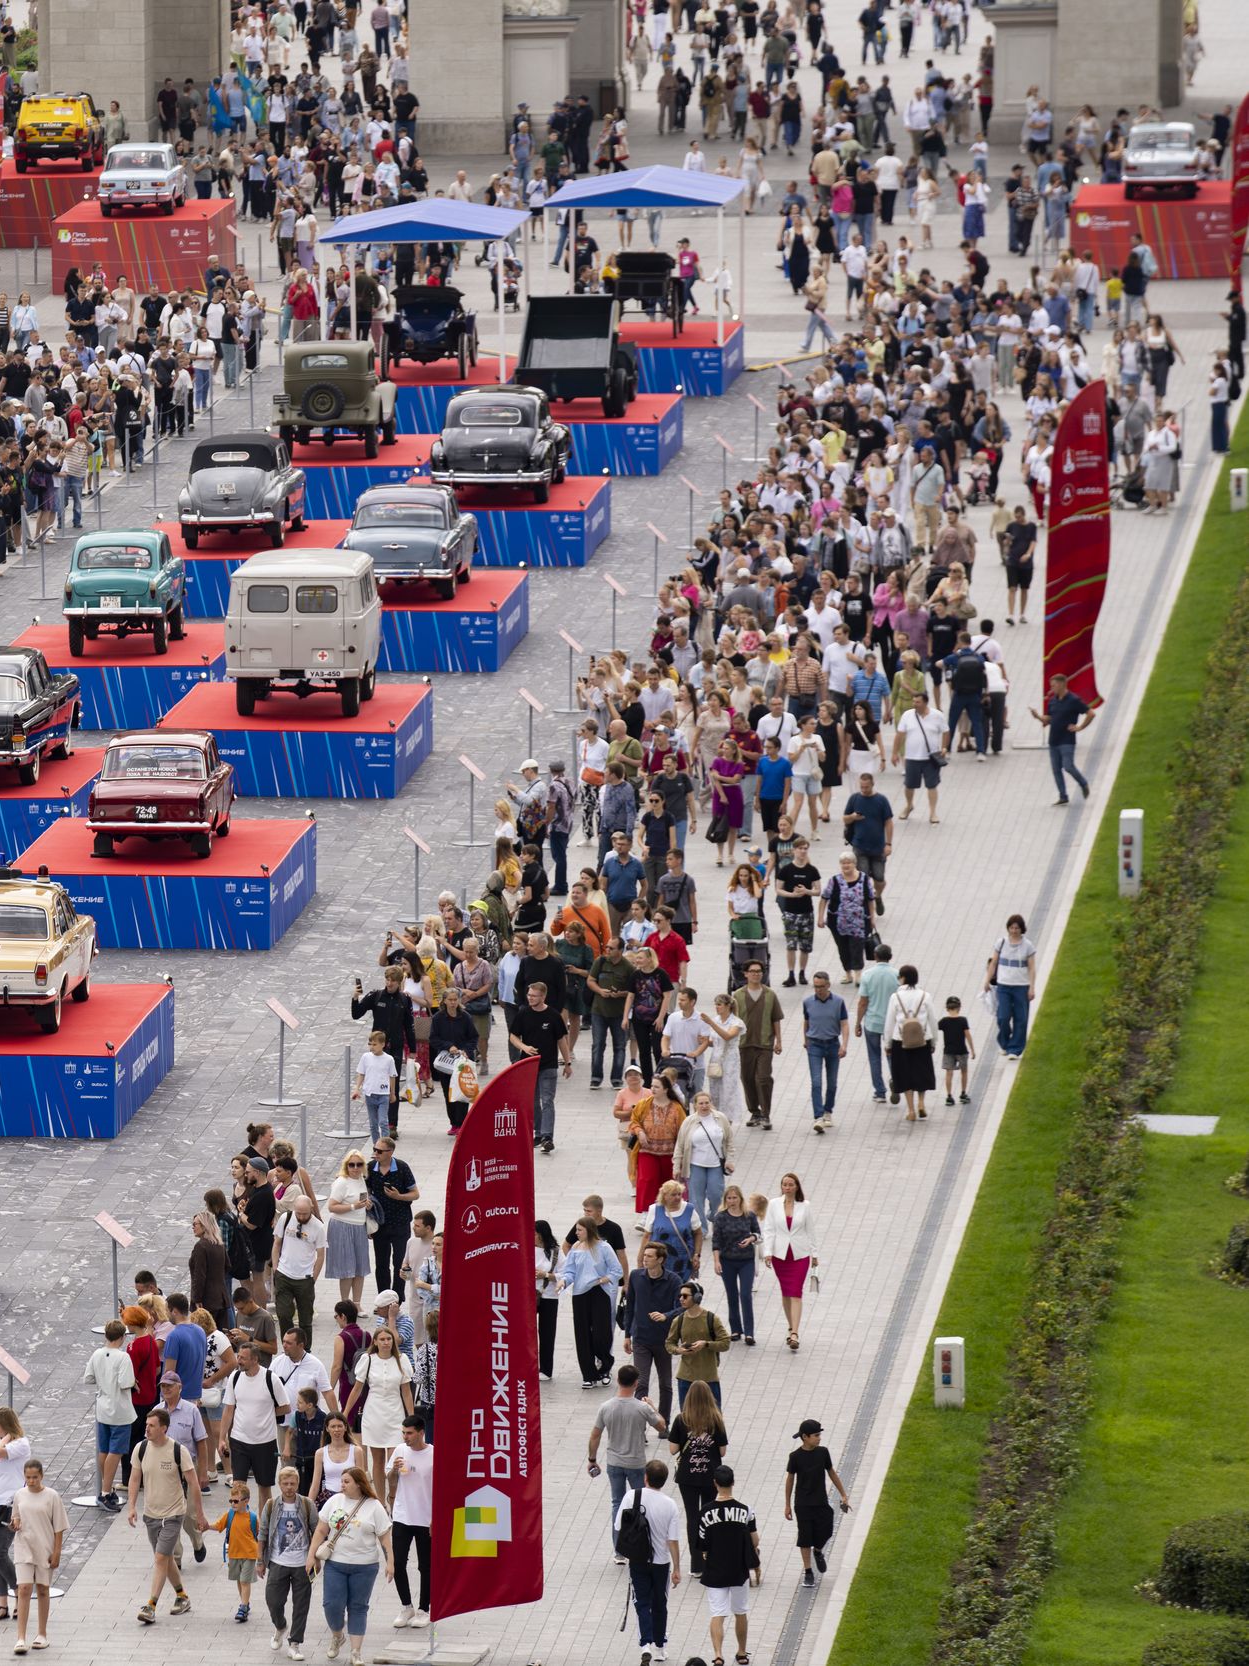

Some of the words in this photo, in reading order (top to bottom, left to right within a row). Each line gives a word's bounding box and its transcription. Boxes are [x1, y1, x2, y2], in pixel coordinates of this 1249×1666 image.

[494, 1128, 517, 1137] ВДНХ
[485, 1206, 519, 1217] auto.ru
[464, 1241, 510, 1260] CORDIANT
[517, 1379, 527, 1414] ВДНХ
[466, 1408, 485, 1478] ПРО
[517, 1416, 528, 1477] АВТОФЕСТ
